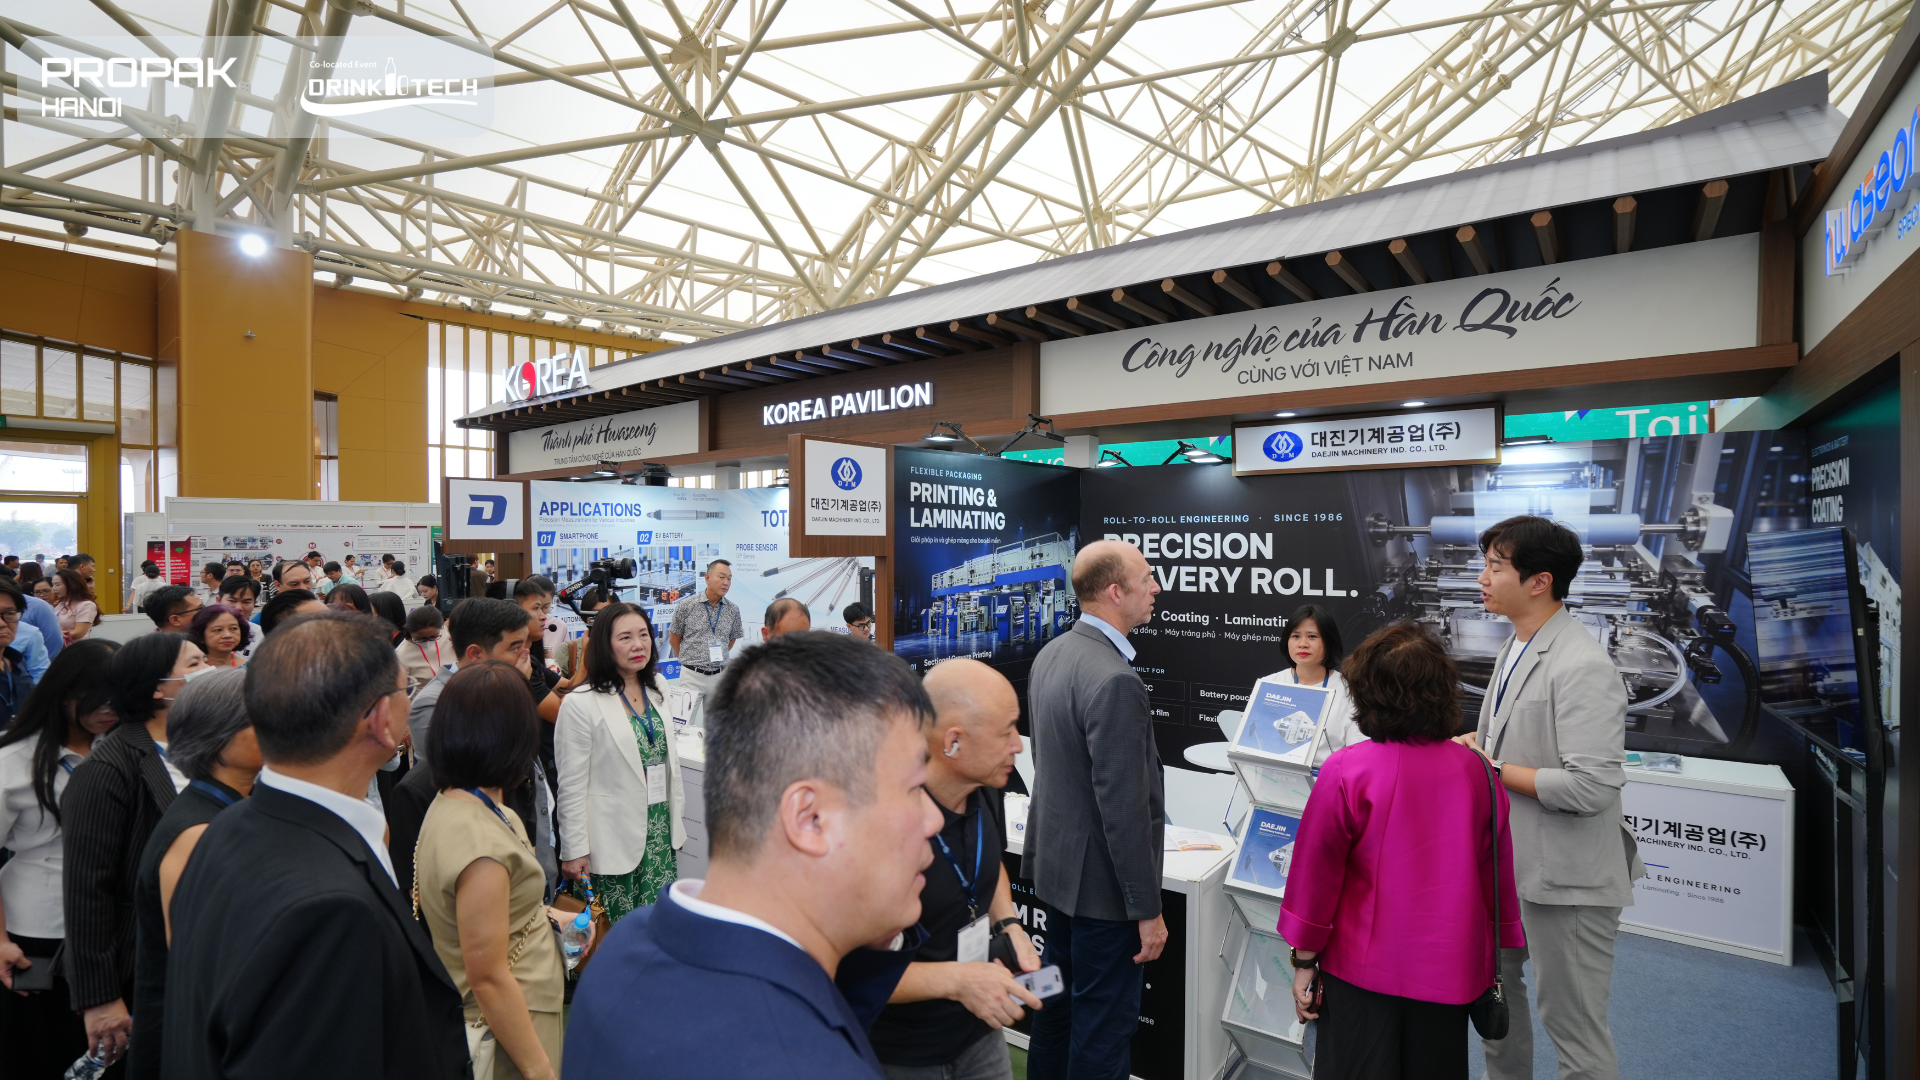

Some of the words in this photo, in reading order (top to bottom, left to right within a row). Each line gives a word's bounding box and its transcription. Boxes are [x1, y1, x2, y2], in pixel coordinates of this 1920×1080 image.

[1121, 337, 1202, 378] Công
[1202, 323, 1283, 373] nghệ
[1283, 316, 1348, 349] của
[1353, 296, 1448, 344] Hàn
[1453, 277, 1582, 340] Quốc
[502, 349, 588, 403] KOREA
[1237, 364, 1287, 385] CÙNG
[1290, 358, 1320, 380] VỚI
[1323, 355, 1363, 378] VIỆT
[1368, 352, 1414, 371] NAM
[763, 397, 827, 426] KOREA
[831, 381, 933, 417] PAVILION
[1310, 421, 1462, 448] 대진기계공업(주)
[1311, 450, 1340, 458] DAEJIN
[1341, 447, 1388, 457] MACHINERY
[1390, 446, 1408, 454] IND.
[1409, 445, 1428, 454] CO.,
[1429, 443, 1448, 452] LTD.
[910, 466, 944, 477] FLEXIBLE
[945, 470, 983, 481] PACKAGING
[1811, 457, 1850, 492] PRECISION
[910, 482, 985, 507] PRINTING
[986, 488, 998, 507] &
[539, 501, 642, 517] APPLICATIONS
[811, 498, 882, 512] 대진기계공업(주)
[1811, 495, 1844, 523] COATING
[761, 510, 789, 528] TOT
[910, 507, 1006, 530] LAMINATING
[1103, 516, 1177, 524] ROLL-TO-ROLL
[1180, 514, 1250, 523] ENGINEERING
[1273, 513, 1309, 522] SINCE
[1313, 513, 1343, 522] 1986
[540, 534, 552, 544] 01
[640, 533, 650, 543] 02
[736, 543, 754, 551] PROBE
[755, 543, 778, 551] SENSOR
[1150, 566, 1243, 593] VERY
[1251, 568, 1359, 598] ROLL.
[1161, 610, 1210, 626] Coating
[972, 651, 992, 659] Printing
[1199, 689, 1229, 701] Battery
[1265, 692, 1292, 703] DAEJIN
[1260, 821, 1287, 833] DAEJIN
[1687, 844, 1706, 853] IND.
[1708, 847, 1728, 857] CO.,
[1730, 851, 1751, 860] LTD.
[1642, 884, 1680, 897] Laminating
[1686, 892, 1707, 901] Since
[1657, 874, 1742, 895] ENGINEERING
